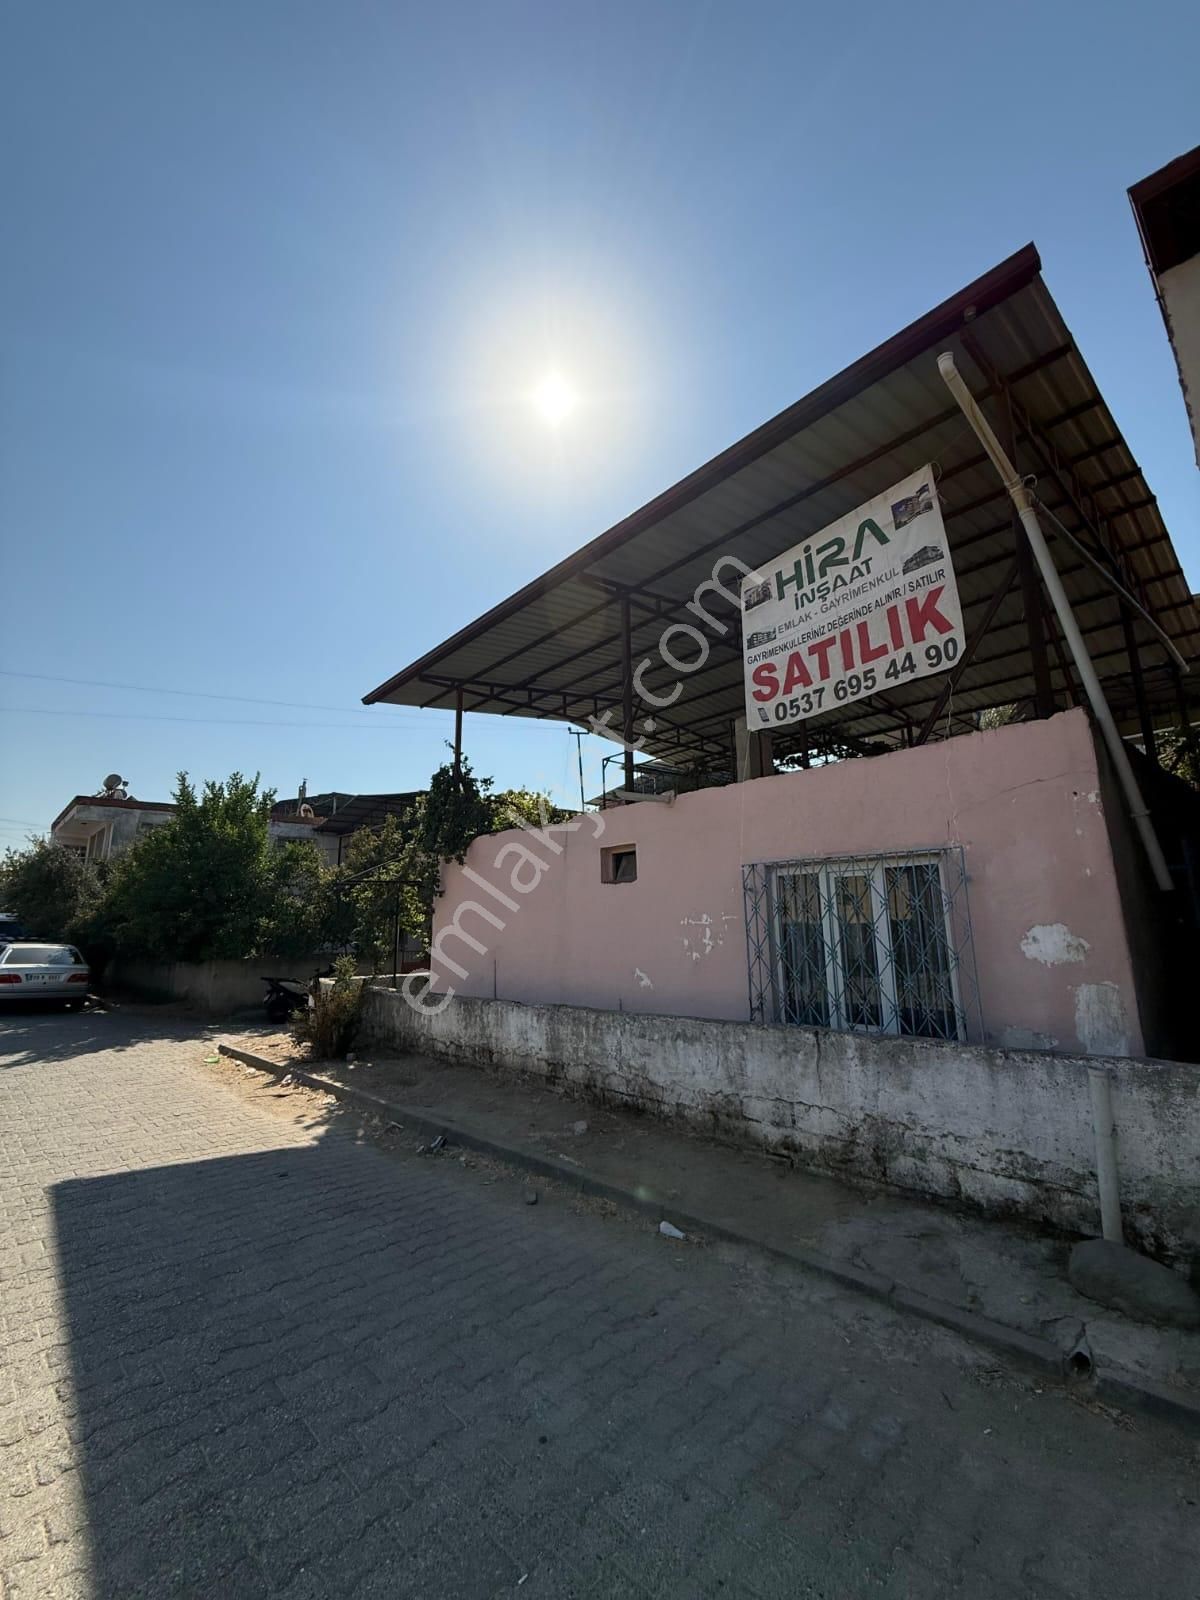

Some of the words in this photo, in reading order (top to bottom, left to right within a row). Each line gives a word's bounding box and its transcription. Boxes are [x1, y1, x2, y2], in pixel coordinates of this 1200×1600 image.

[775, 518, 890, 601] HİRA
[794, 557, 873, 610] İNŞAAT
[778, 611, 813, 634] EMLAK
[820, 567, 900, 614] GAYRİMENKUL
[828, 603, 873, 633] DEĞERİNDE
[874, 587, 901, 610] ALINIR
[908, 568, 946, 592] SATILIR
[751, 585, 955, 703] SATILIK
[774, 687, 826, 721] 0537
[833, 668, 877, 701] 695
[885, 652, 917, 680] 44
[925, 637, 958, 668] 90
